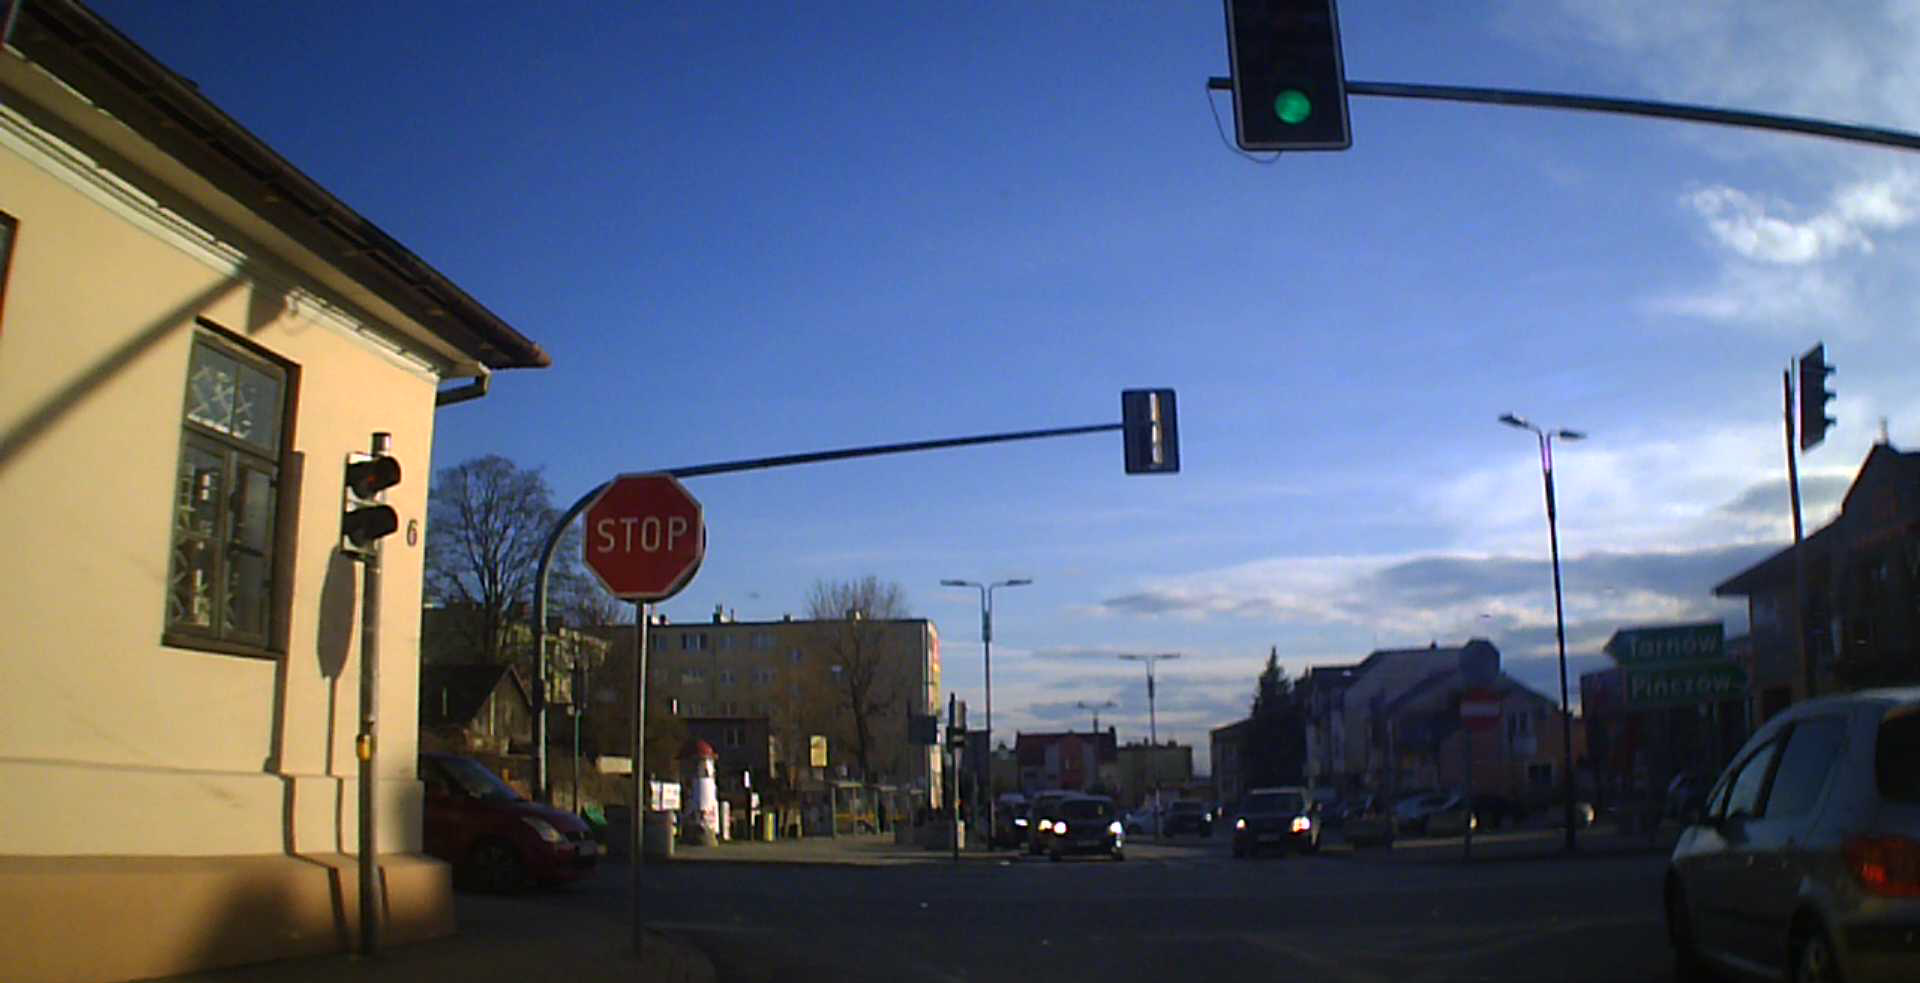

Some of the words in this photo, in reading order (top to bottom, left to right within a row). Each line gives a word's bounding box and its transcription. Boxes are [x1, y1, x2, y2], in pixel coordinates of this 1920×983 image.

[406, 518, 418, 547] 6
[597, 516, 688, 554] STOP
[1630, 628, 1719, 657] Tarnów
